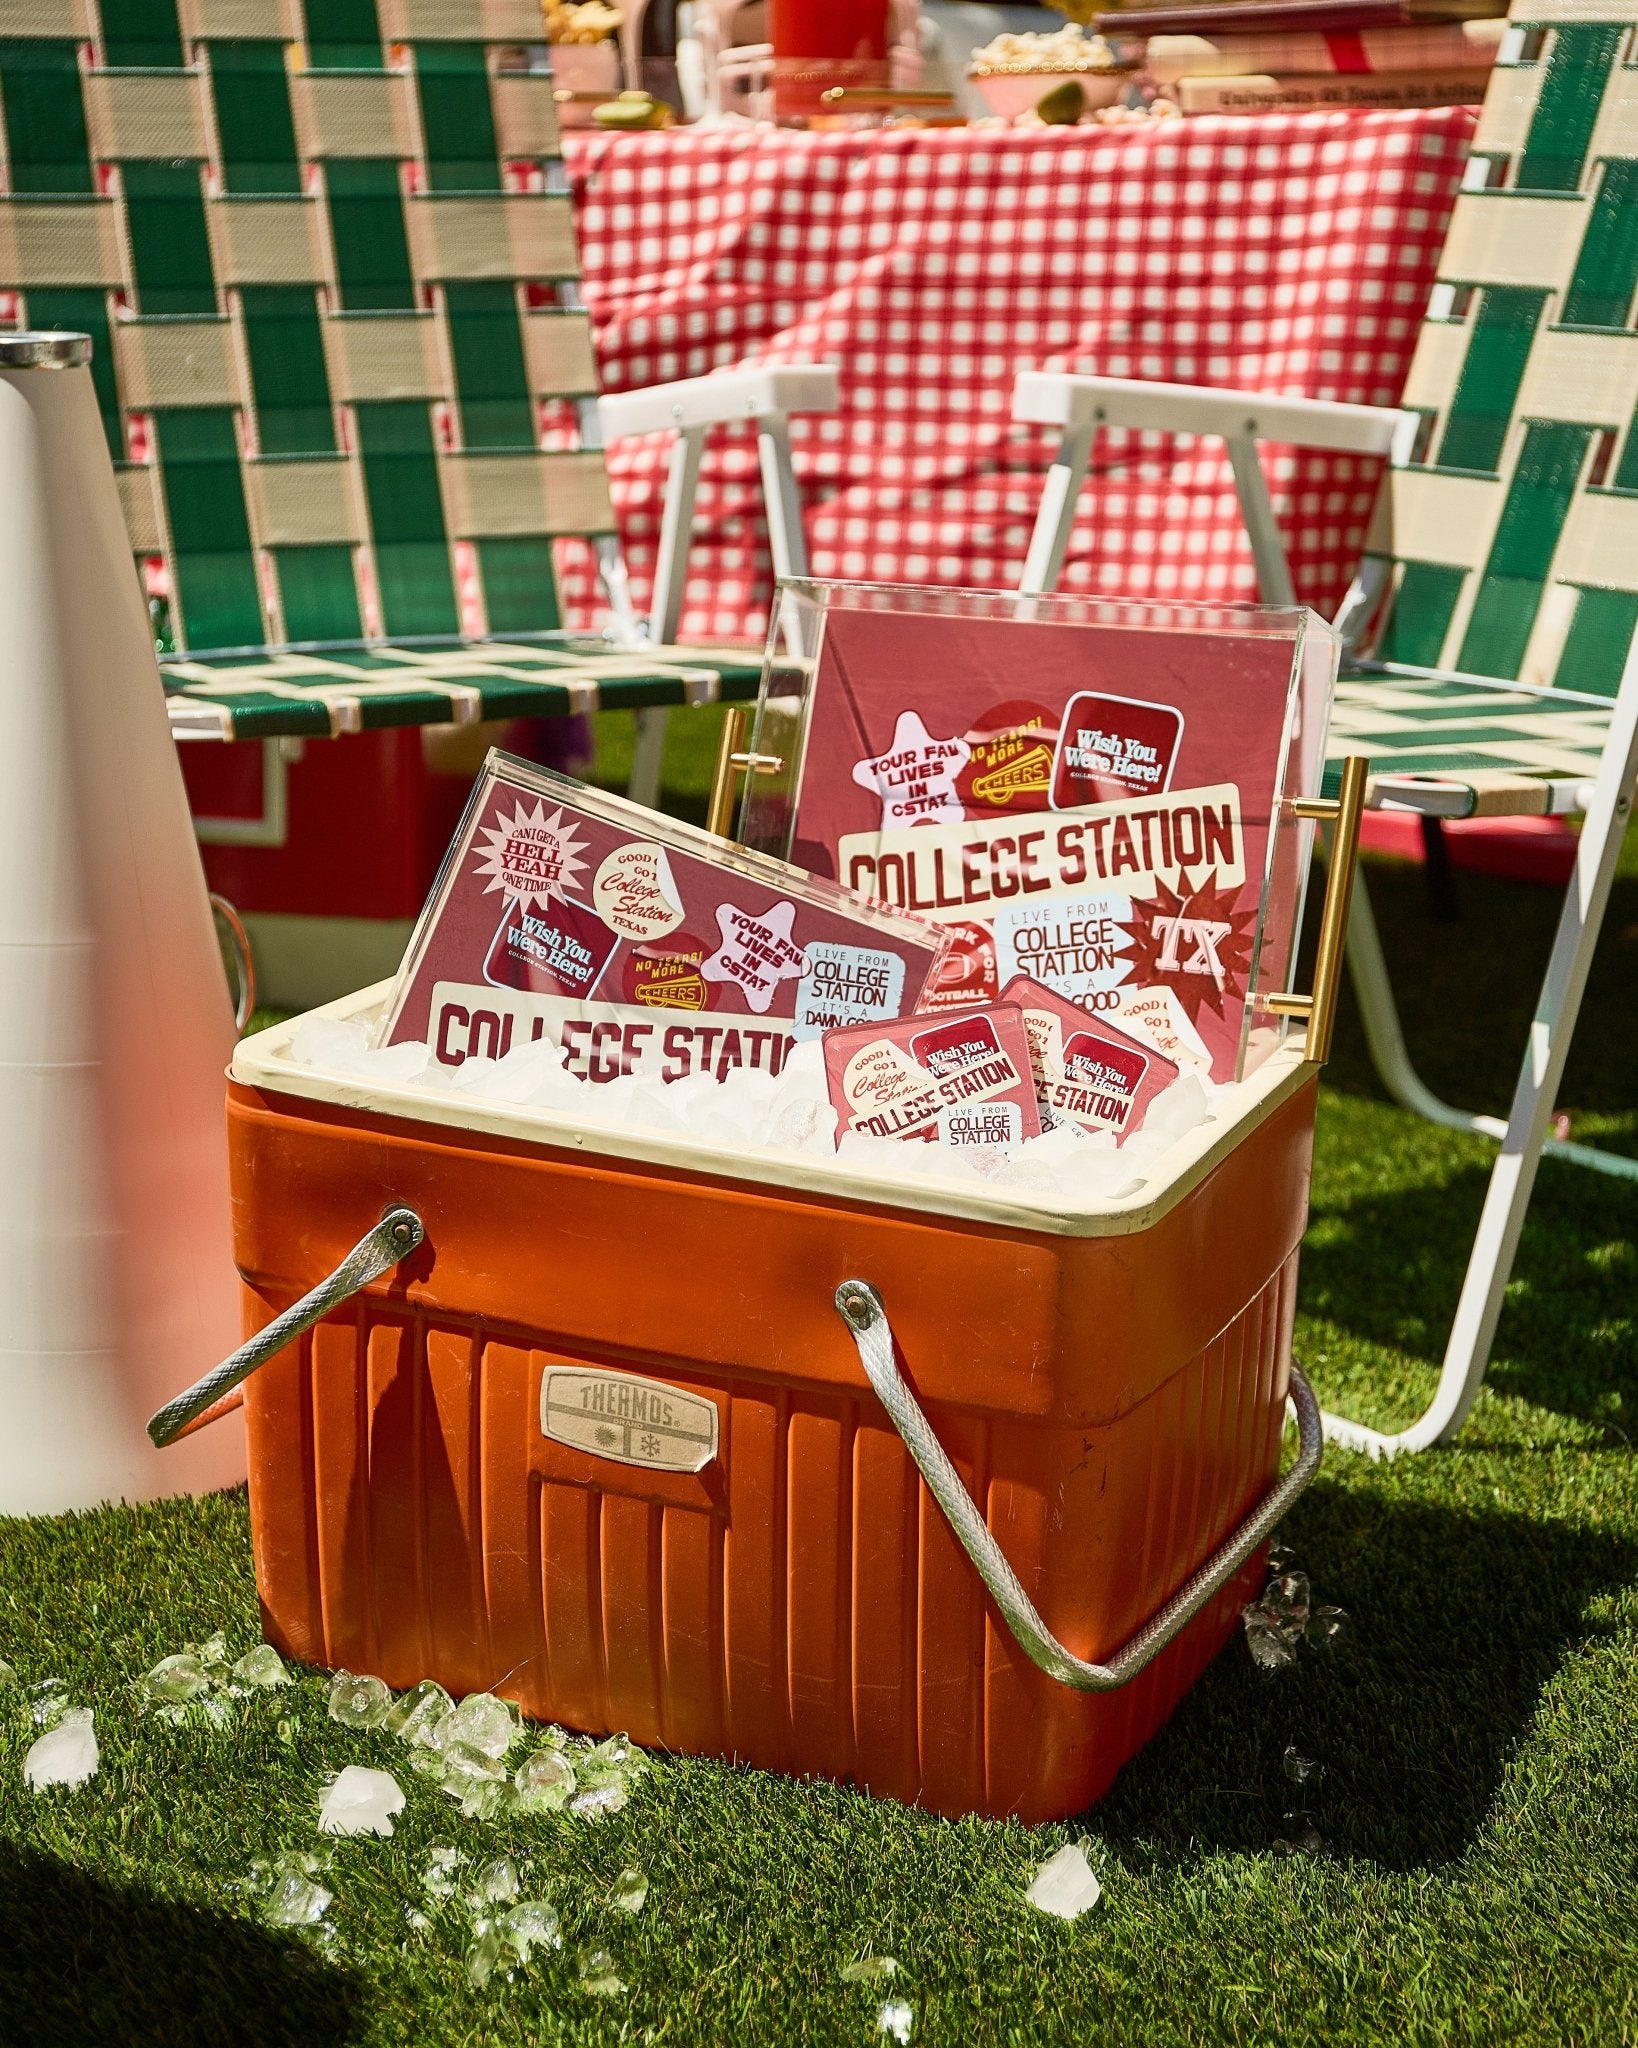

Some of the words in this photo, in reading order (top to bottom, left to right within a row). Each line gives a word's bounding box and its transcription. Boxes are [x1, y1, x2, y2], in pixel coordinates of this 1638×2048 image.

[986, 740, 1024, 768] MORE
[1077, 729, 1123, 756] Wish
[1124, 738, 1158, 763] You
[869, 750, 917, 776] YOUR
[887, 760, 945, 787] LIVES
[985, 763, 1045, 789] CHEERS
[1064, 746, 1111, 773] Were
[1111, 755, 1163, 783] Here!
[908, 782, 928, 799] IN
[891, 793, 950, 817] CSTAT
[512, 827, 532, 839] CAN
[536, 829, 555, 846] GET
[503, 838, 564, 866] HELL
[617, 853, 652, 864] GOOD
[849, 830, 1051, 912] COLLEGE
[1057, 804, 1235, 885] STATION
[500, 853, 563, 881] YEAH
[634, 866, 650, 878] GO
[502, 871, 523, 891] ONE
[523, 877, 552, 892] TIME
[600, 872, 661, 902] College
[612, 895, 673, 923] Station
[1011, 908, 1051, 925] LIVE
[1066, 901, 1109, 918] FROM
[612, 915, 648, 935] TEXAS
[729, 912, 773, 944] YOUR
[1013, 917, 1114, 954] COLLEGE
[522, 914, 562, 949] Wish
[561, 935, 592, 965] You
[734, 930, 786, 969] LIVES
[1151, 915, 1232, 977] TX
[507, 925, 547, 960] Were
[545, 948, 594, 983] Here!
[635, 960, 652, 972] NO
[658, 951, 703, 967] TEARS!
[741, 952, 762, 972] IN
[815, 947, 847, 961] LIVE
[857, 954, 889, 968] FROM
[977, 943, 995, 984] FOR
[1016, 944, 1115, 978] STATION
[508, 949, 535, 966] COLLEGE
[558, 974, 577, 988] TEXAS
[651, 964, 684, 979] MORE
[719, 955, 771, 992] CSTAT
[813, 960, 891, 989] COLLEGE
[645, 987, 696, 1000] CHEERS
[810, 979, 887, 1007] STATION
[1087, 978, 1096, 989] A
[805, 1010, 843, 1028] DAMN
[821, 1002, 850, 1015] IT'S
[860, 1008, 867, 1017] A
[855, 1051, 884, 1071] GOOD
[926, 1045, 963, 1065] Wish
[960, 1040, 987, 1054] You
[928, 1059, 961, 1077] Were
[959, 1046, 995, 1067] Here!
[873, 1062, 890, 1071] GO
[1072, 1054, 1104, 1076] Wish
[1103, 1066, 1127, 1085] You
[852, 1071, 907, 1098] College
[855, 1089, 944, 1137] COLLEGE
[939, 1057, 1015, 1105] STATION
[948, 1108, 973, 1117] LIVE
[981, 1106, 1008, 1115] FROM
[1044, 1108, 1066, 1126] LIVE
[1053, 1085, 1129, 1125] STATION
[948, 1115, 1011, 1131] COLLEGE
[950, 1128, 1011, 1145] STATION
